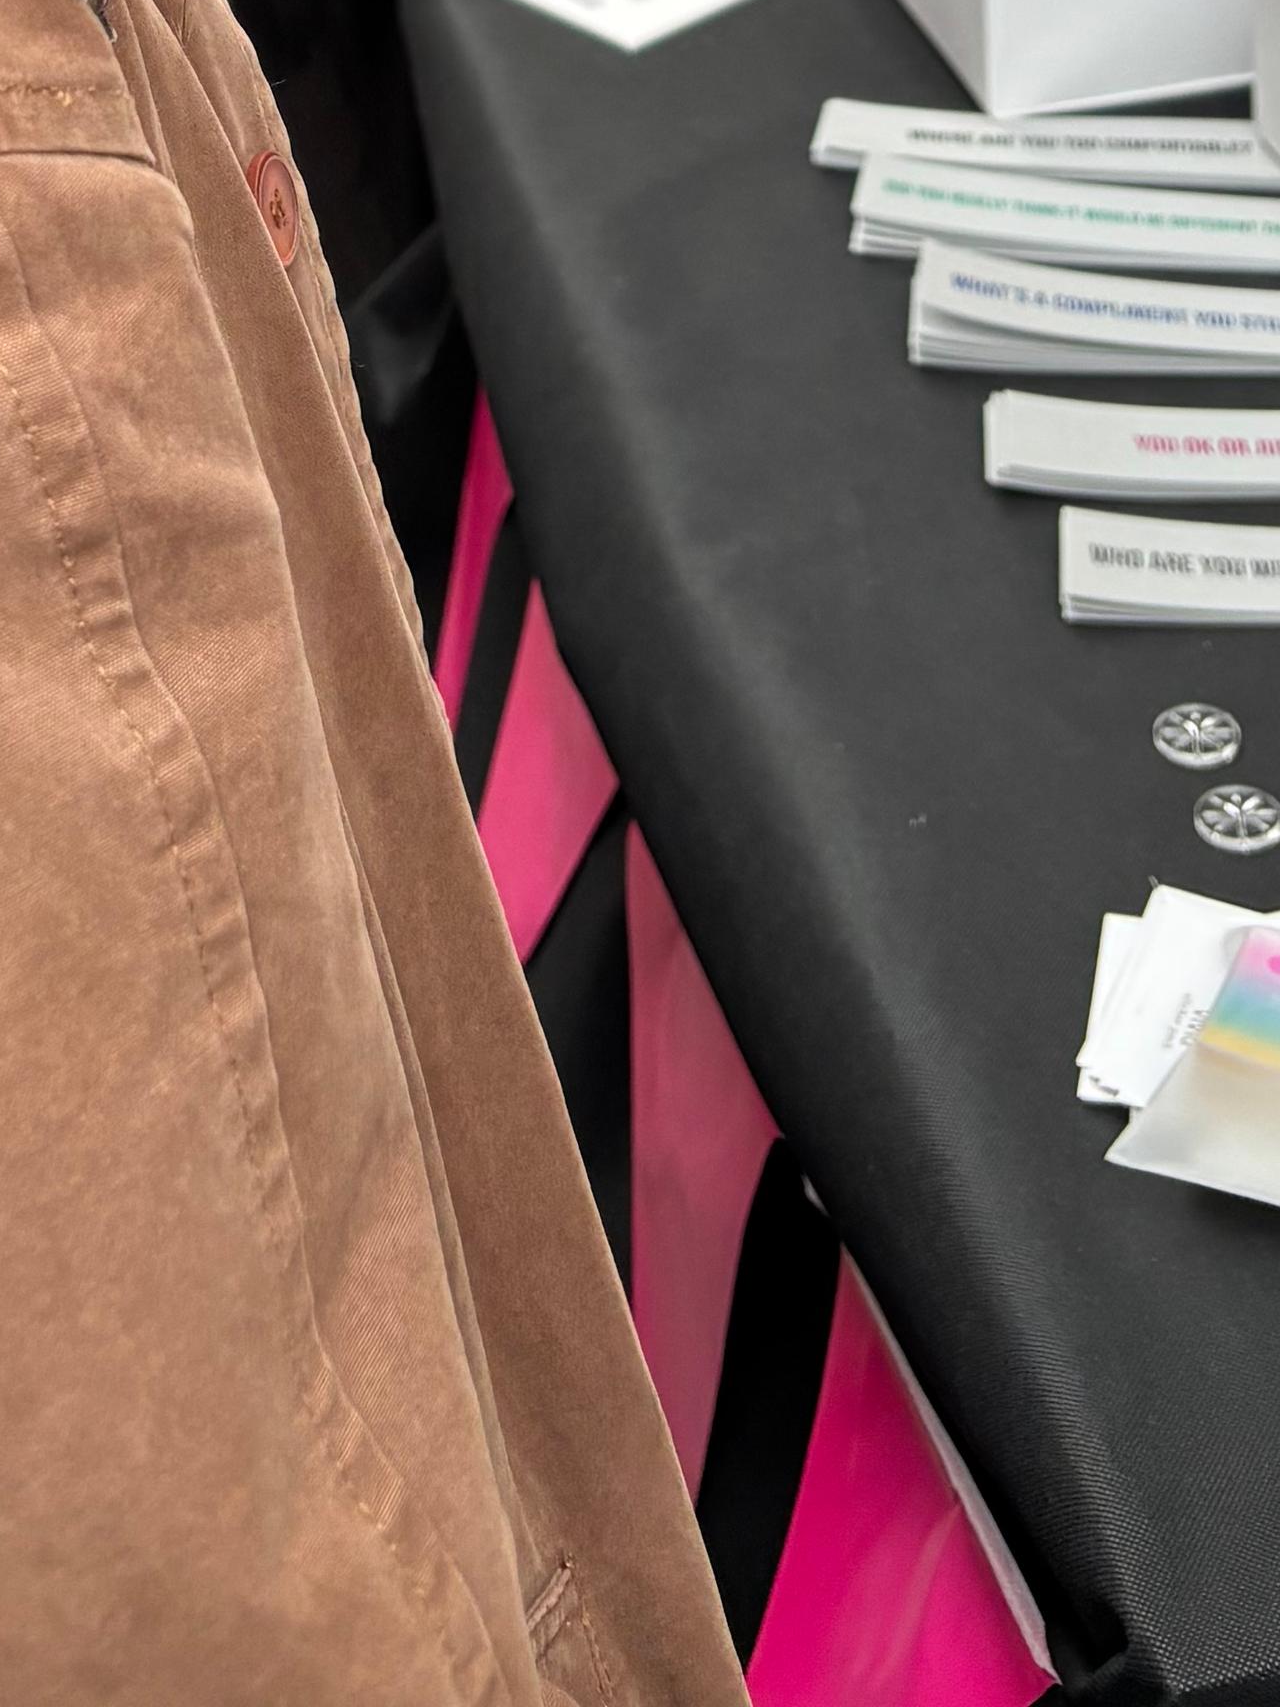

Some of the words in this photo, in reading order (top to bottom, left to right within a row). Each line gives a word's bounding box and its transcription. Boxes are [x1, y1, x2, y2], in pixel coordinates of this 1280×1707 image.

[1089, 542, 1144, 568] WHO
[1147, 550, 1194, 573] ARE
[1197, 554, 1247, 576] YOU
